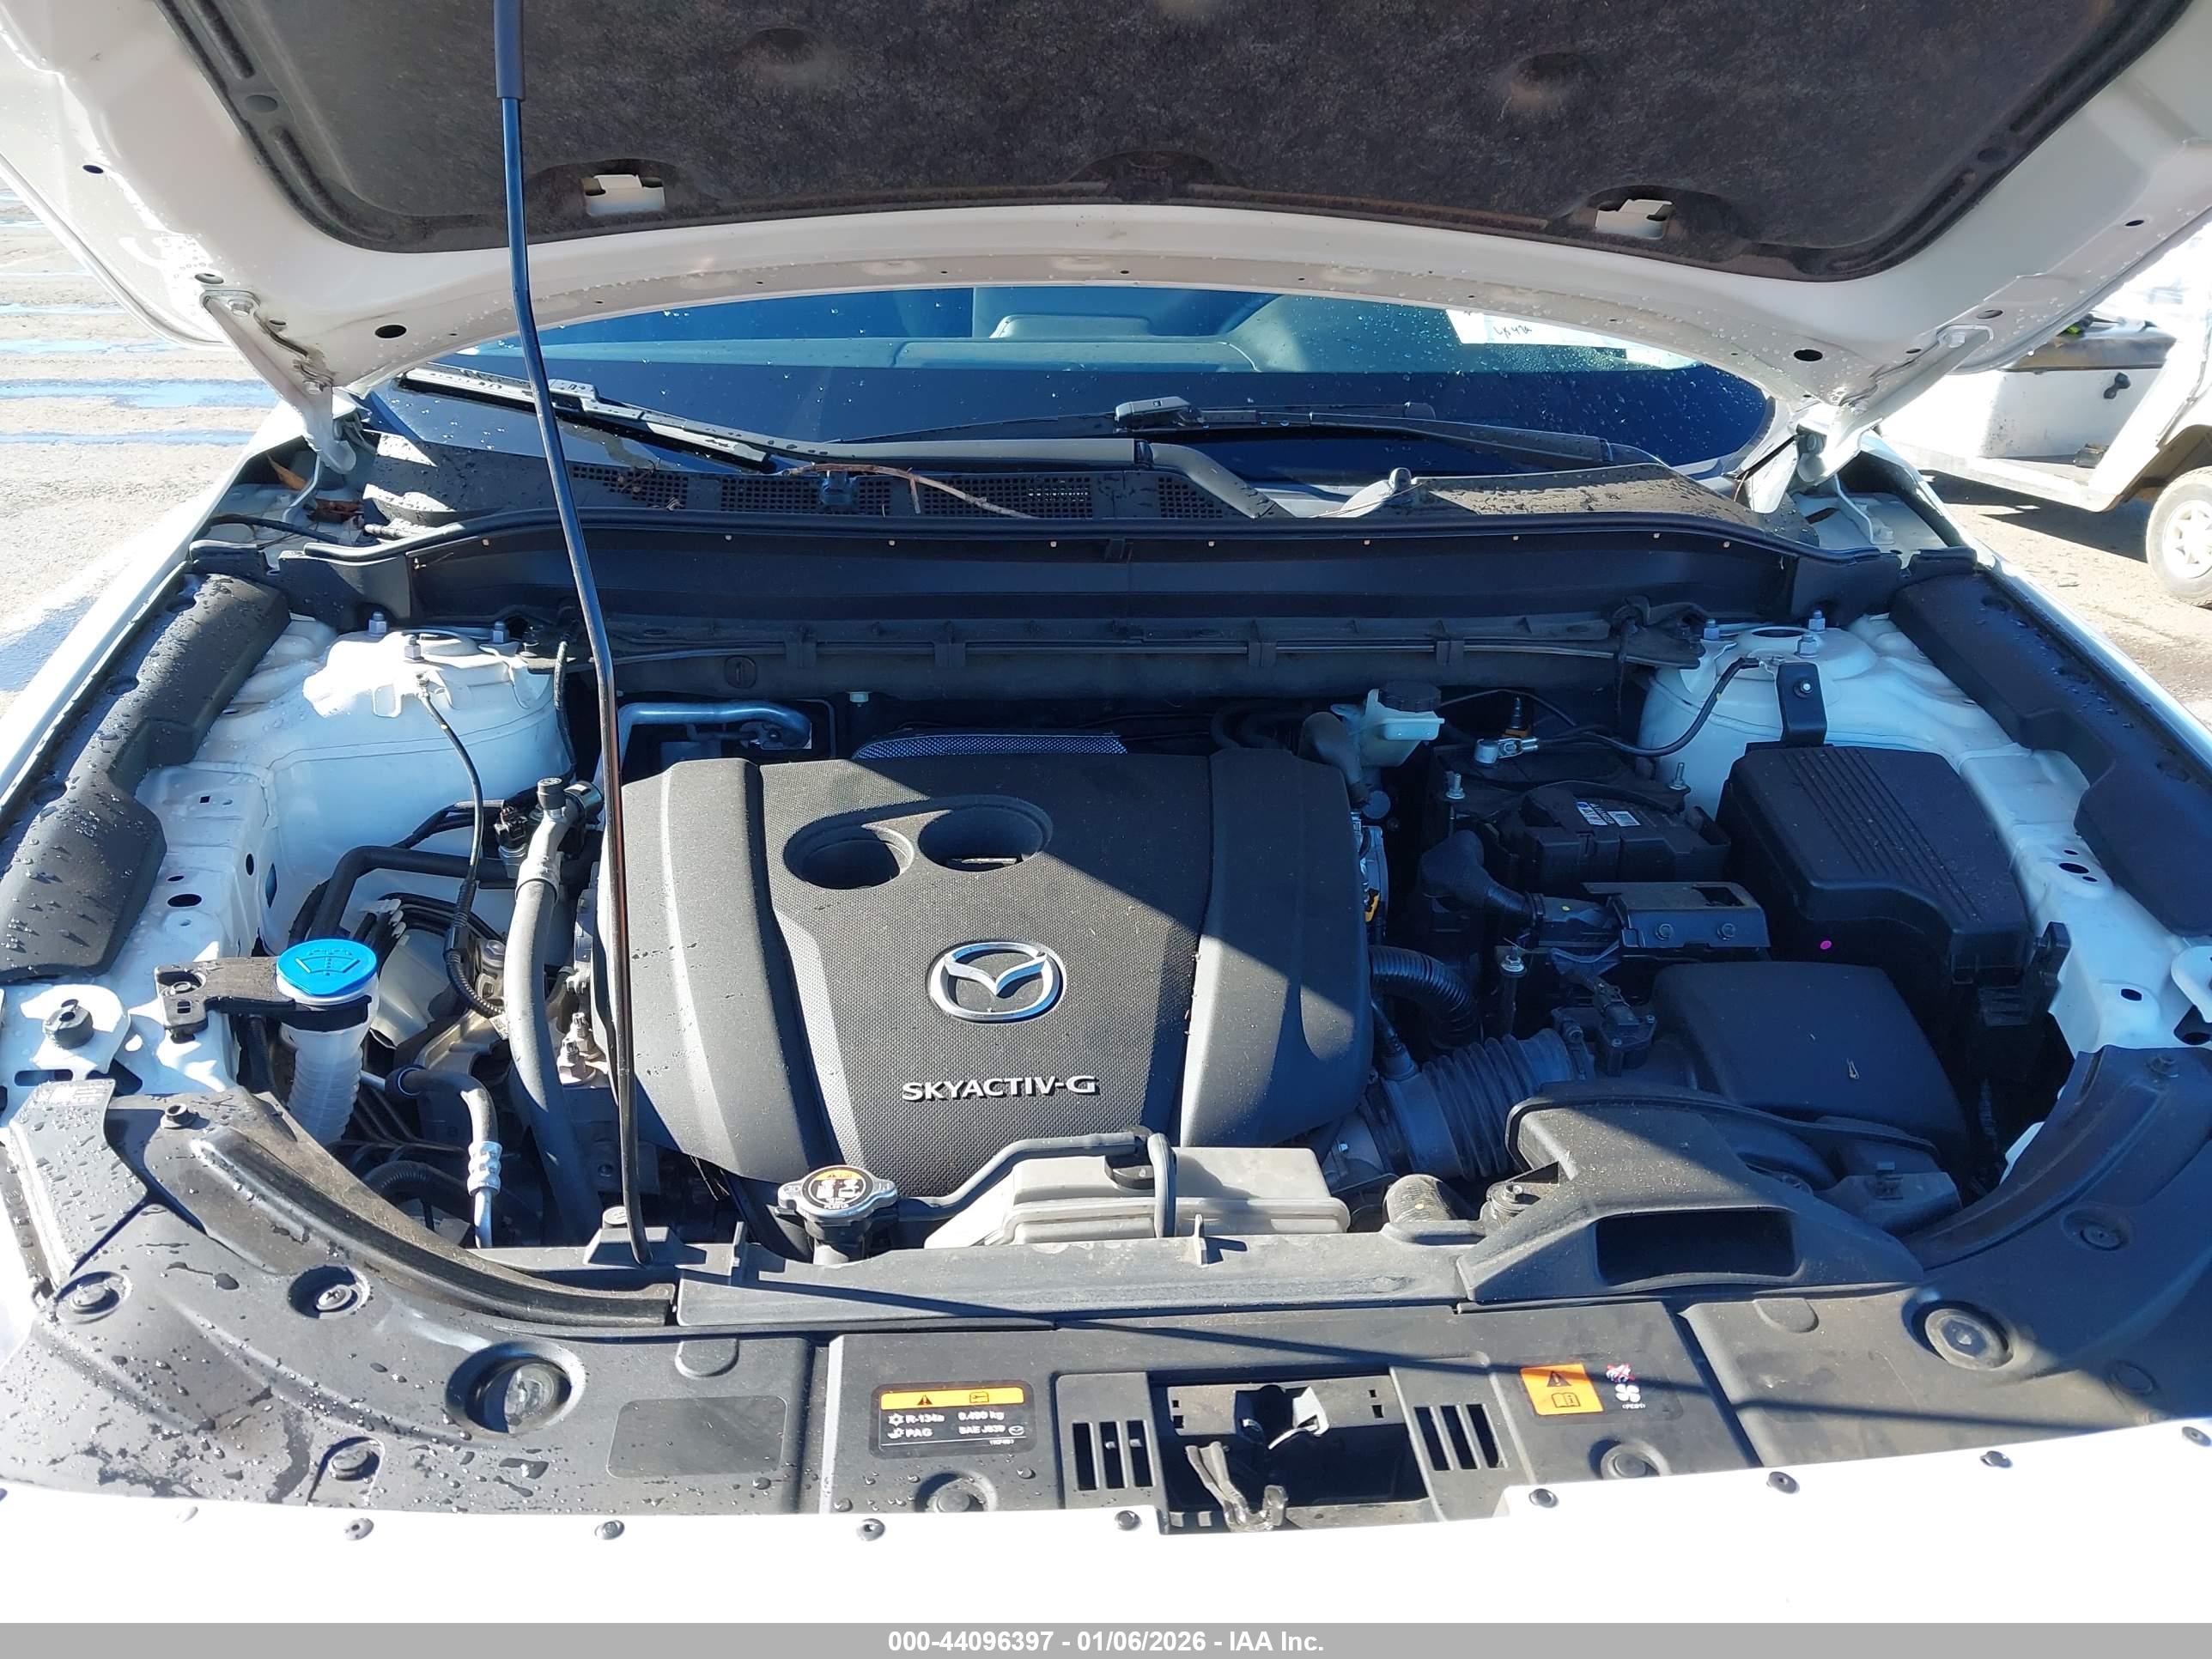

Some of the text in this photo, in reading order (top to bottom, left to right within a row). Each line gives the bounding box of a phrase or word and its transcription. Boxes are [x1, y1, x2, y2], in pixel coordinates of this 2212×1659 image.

[902, 1075, 1098, 1102] SKYACTIV-G
[905, 1413, 945, 1424] R-134a
[989, 1411, 1005, 1420] kg
[905, 1428, 933, 1437] PAG
[958, 1425, 981, 1435] SAE
